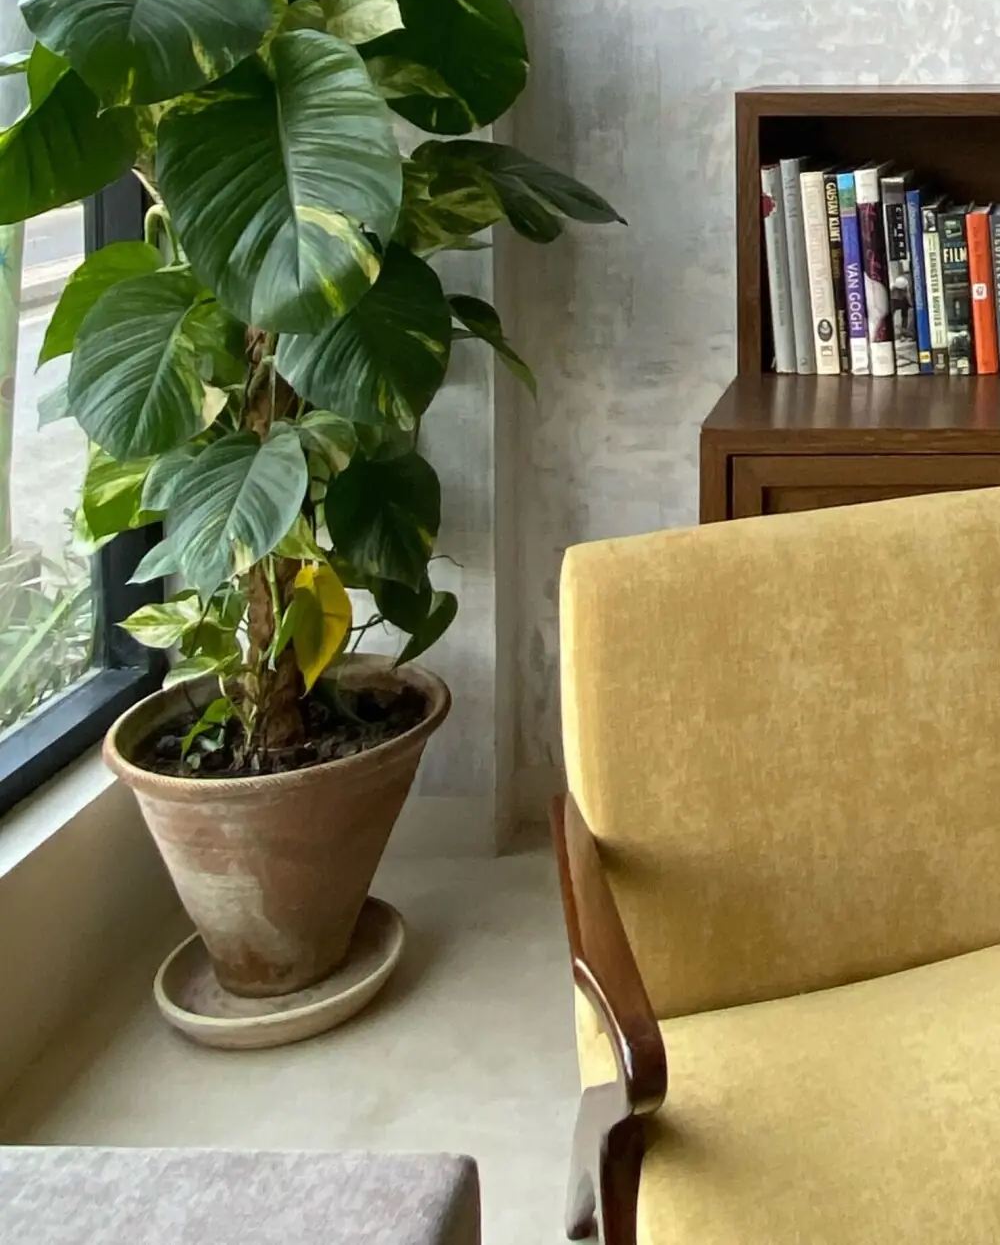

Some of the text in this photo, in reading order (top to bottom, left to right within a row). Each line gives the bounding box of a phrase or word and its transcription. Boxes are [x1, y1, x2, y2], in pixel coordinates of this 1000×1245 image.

[826, 182, 839, 215] GUSTAV
[828, 216, 841, 242] KLIMT
[846, 262, 859, 289] VAN
[929, 251, 943, 327] GANGSTER MOVIES
[849, 291, 863, 331] GOGH
